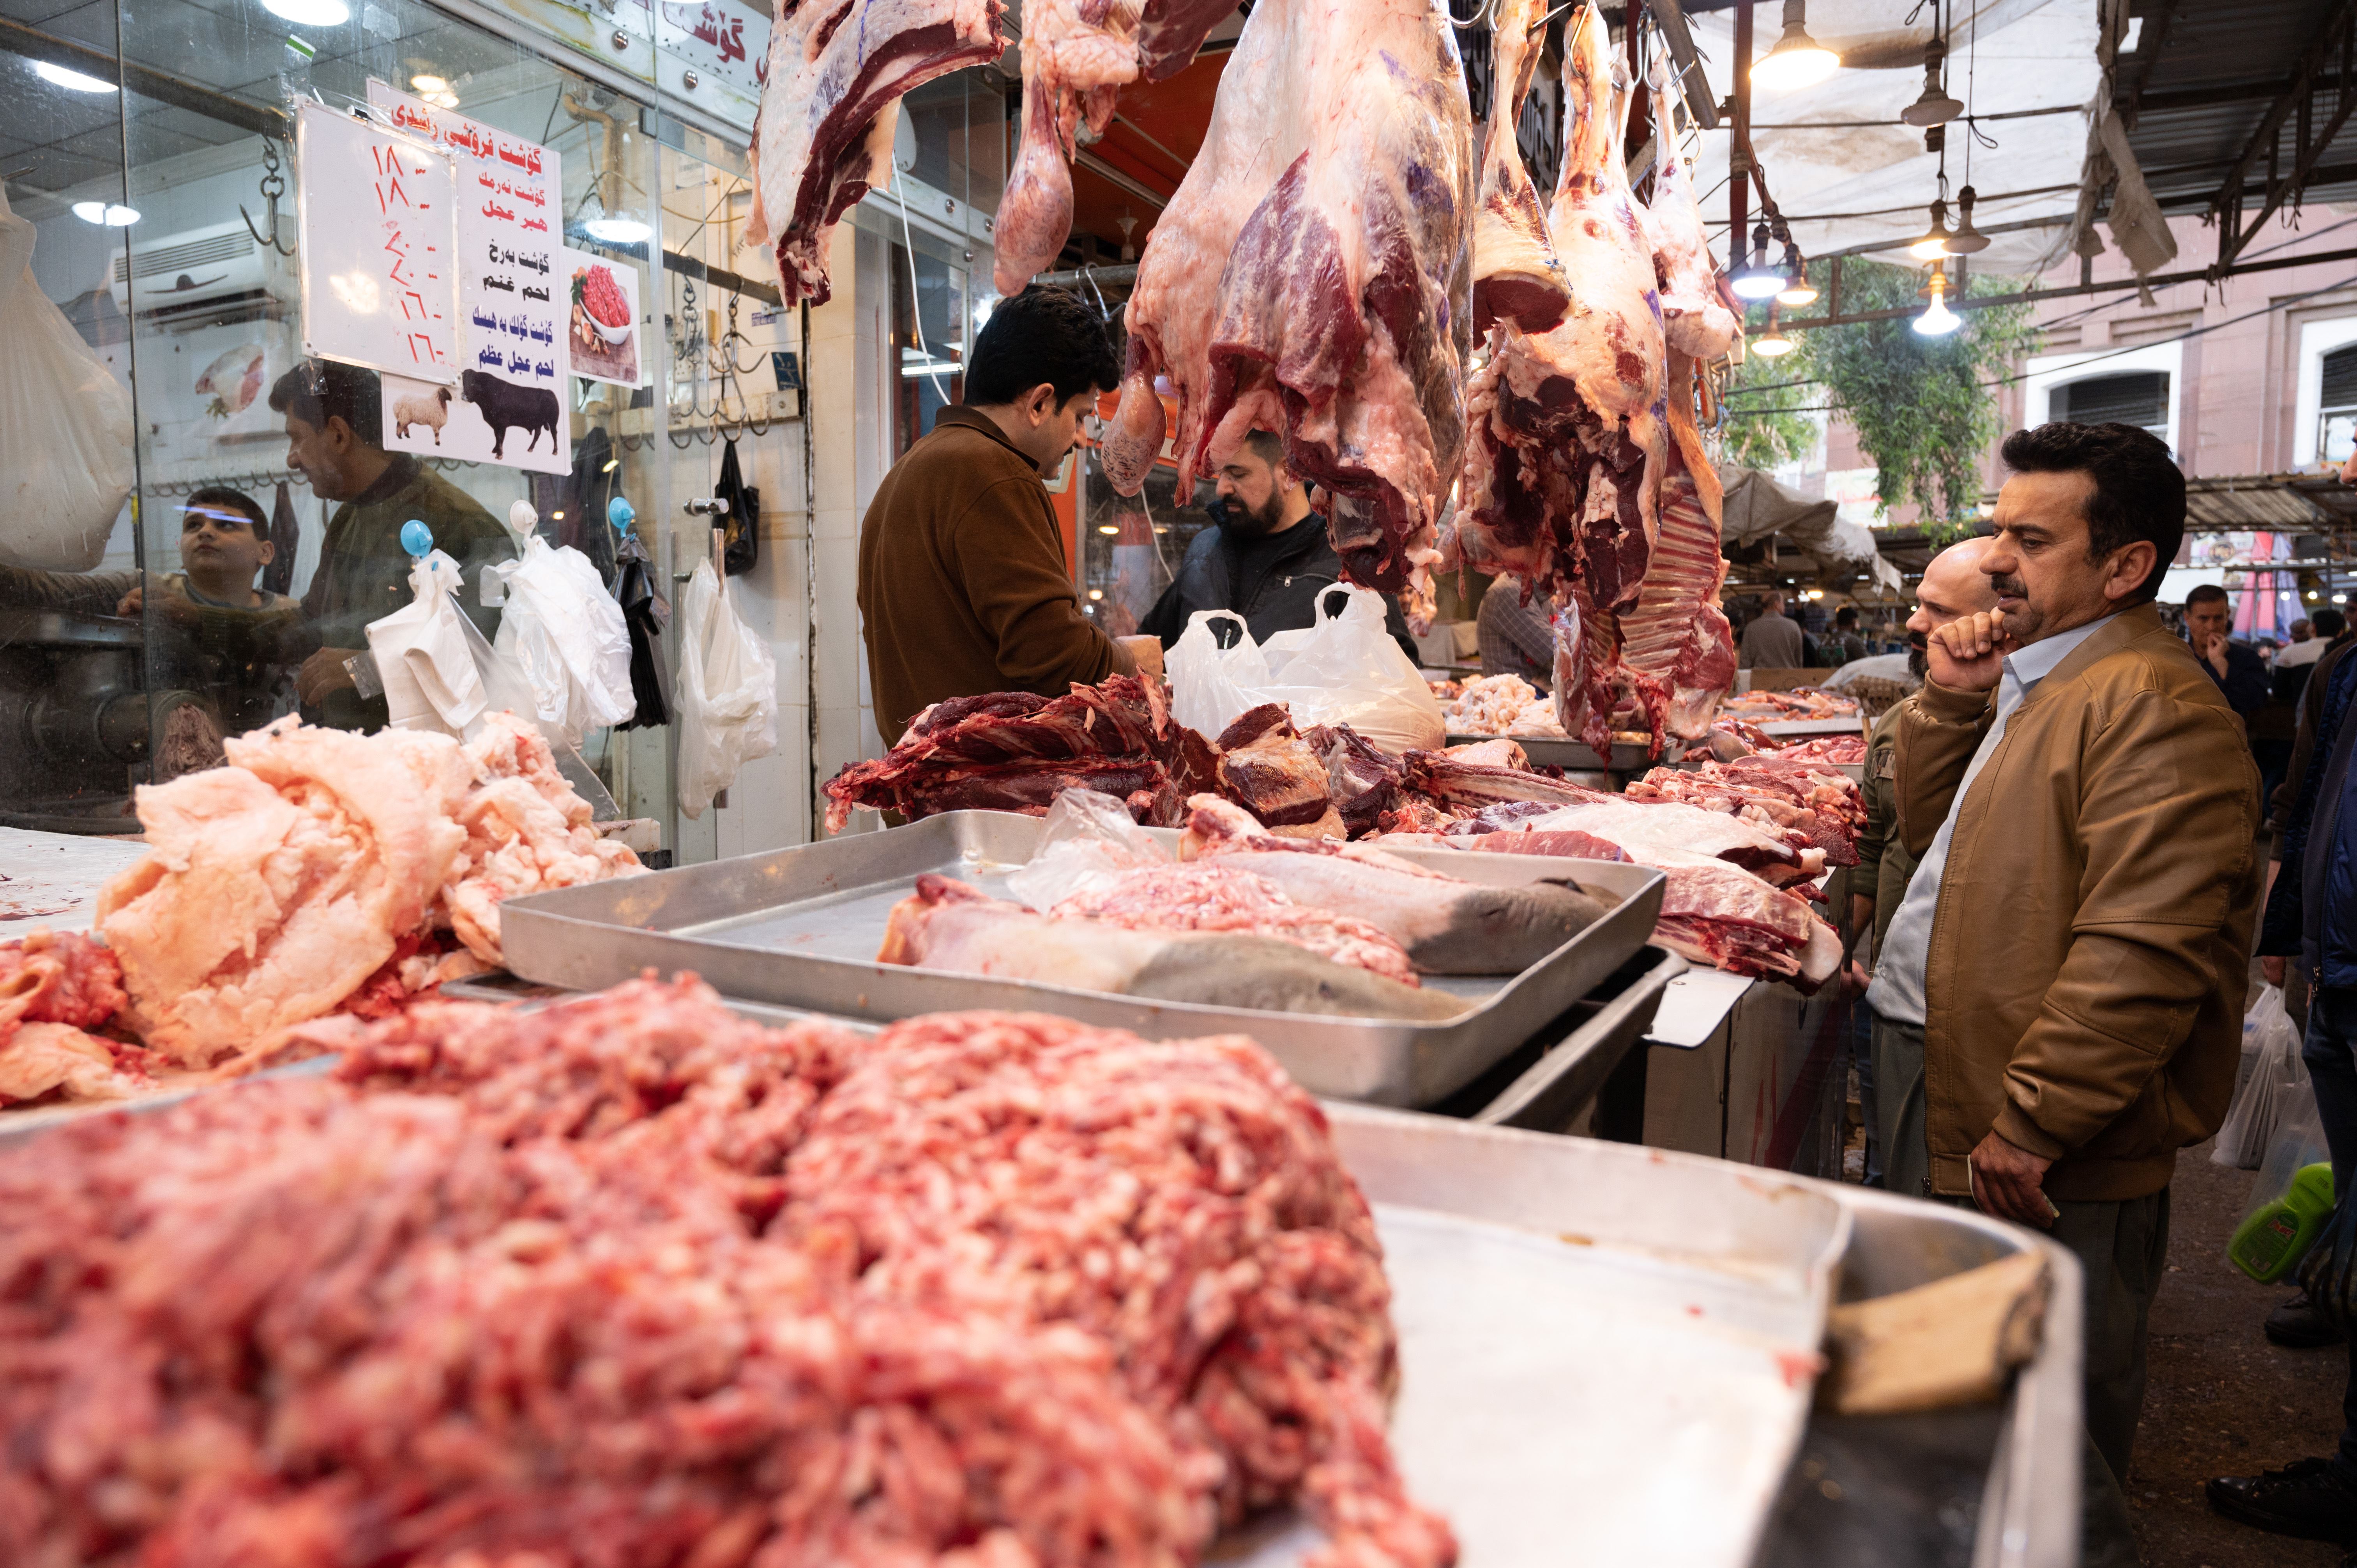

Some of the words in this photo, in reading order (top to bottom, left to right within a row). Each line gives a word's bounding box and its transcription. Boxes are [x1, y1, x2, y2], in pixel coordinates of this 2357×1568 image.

[499, 141, 542, 176] گۆشت
[514, 185, 546, 207] گۆشت
[482, 200, 515, 221] عجل
[520, 217, 548, 233] هبر
[518, 252, 549, 276] گۆشت
[483, 275, 515, 292] غنم
[522, 286, 549, 302] لحم
[530, 320, 553, 348] گۆشت
[479, 343, 503, 369] عظم
[507, 350, 531, 375] عجل
[535, 358, 554, 381] لحم
